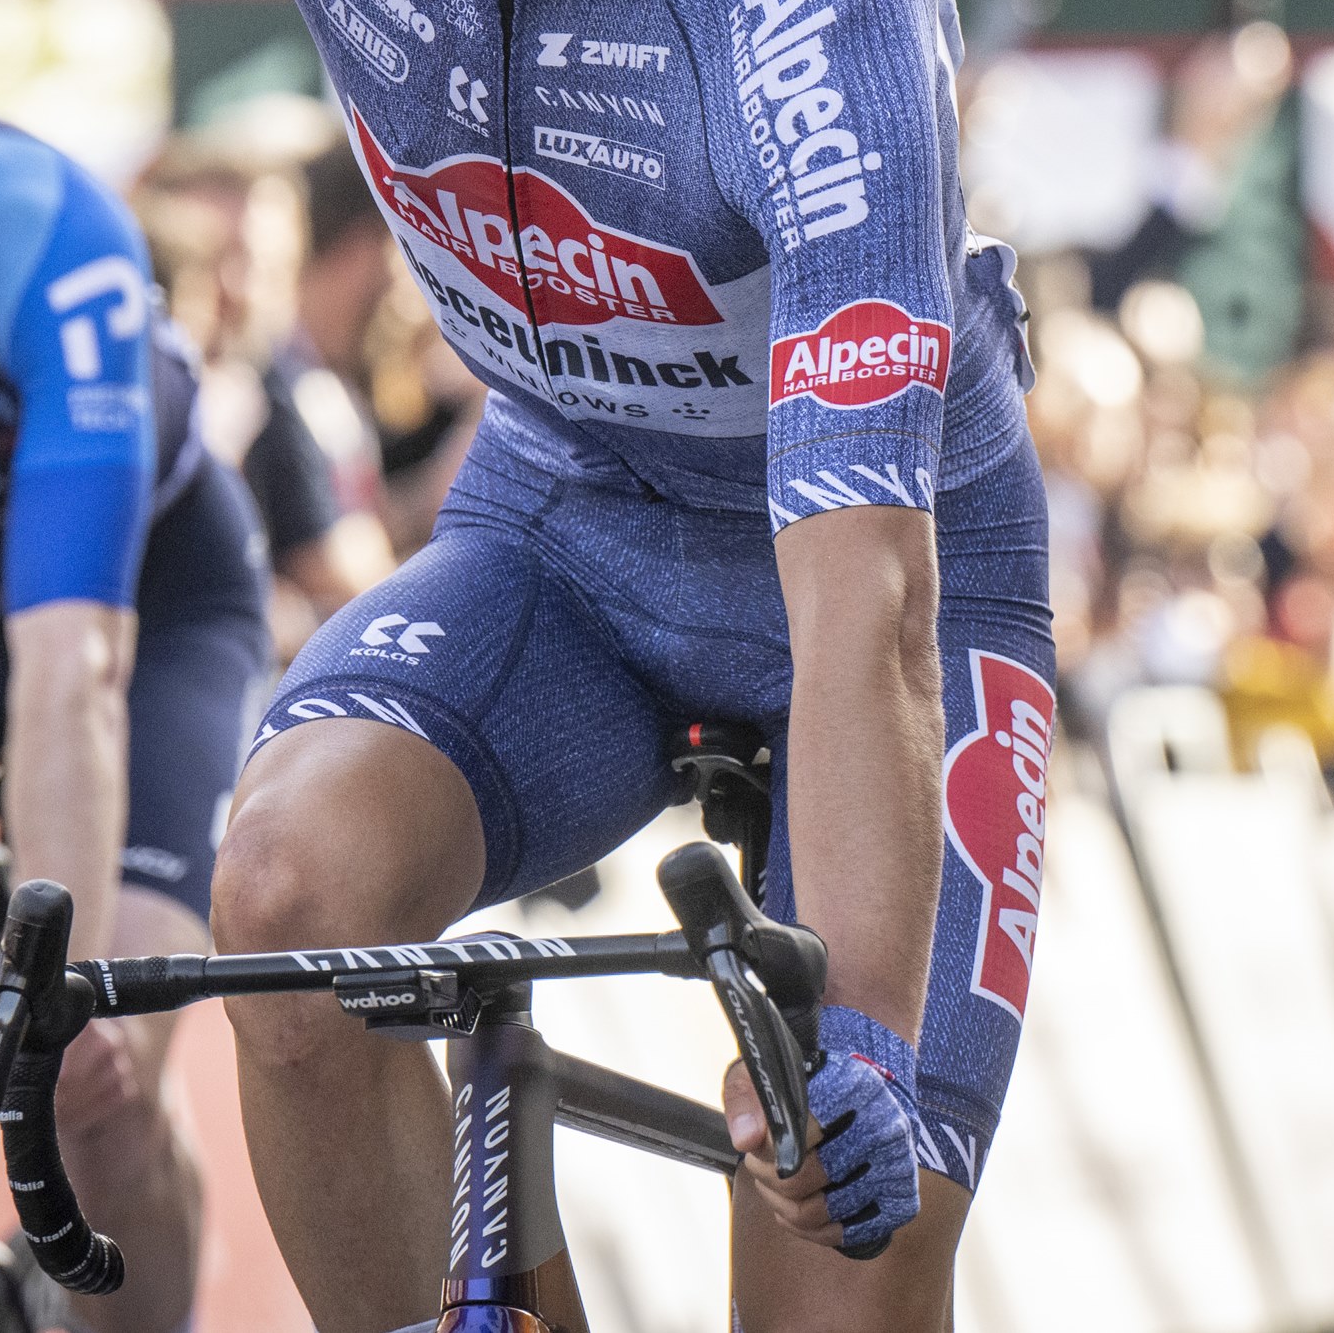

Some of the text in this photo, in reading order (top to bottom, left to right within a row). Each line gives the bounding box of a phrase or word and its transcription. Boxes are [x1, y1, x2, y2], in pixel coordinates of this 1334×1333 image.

[581, 40, 670, 73] ZWIFT
[535, 86, 666, 127] CANYON
[383, 175, 668, 309] Alpecin
[399, 203, 475, 259] HAIR
[784, 325, 941, 384] Alpecin
[479, 341, 651, 418] WINOWS
[783, 364, 938, 396] HAIR BOOSTER
[290, 937, 578, 971] CANYON
[338, 991, 416, 1010] wahoo
[0, 1110, 23, 1121] talia
[449, 1082, 473, 1273] CANYON
[480, 1084, 511, 1269] CANYON
